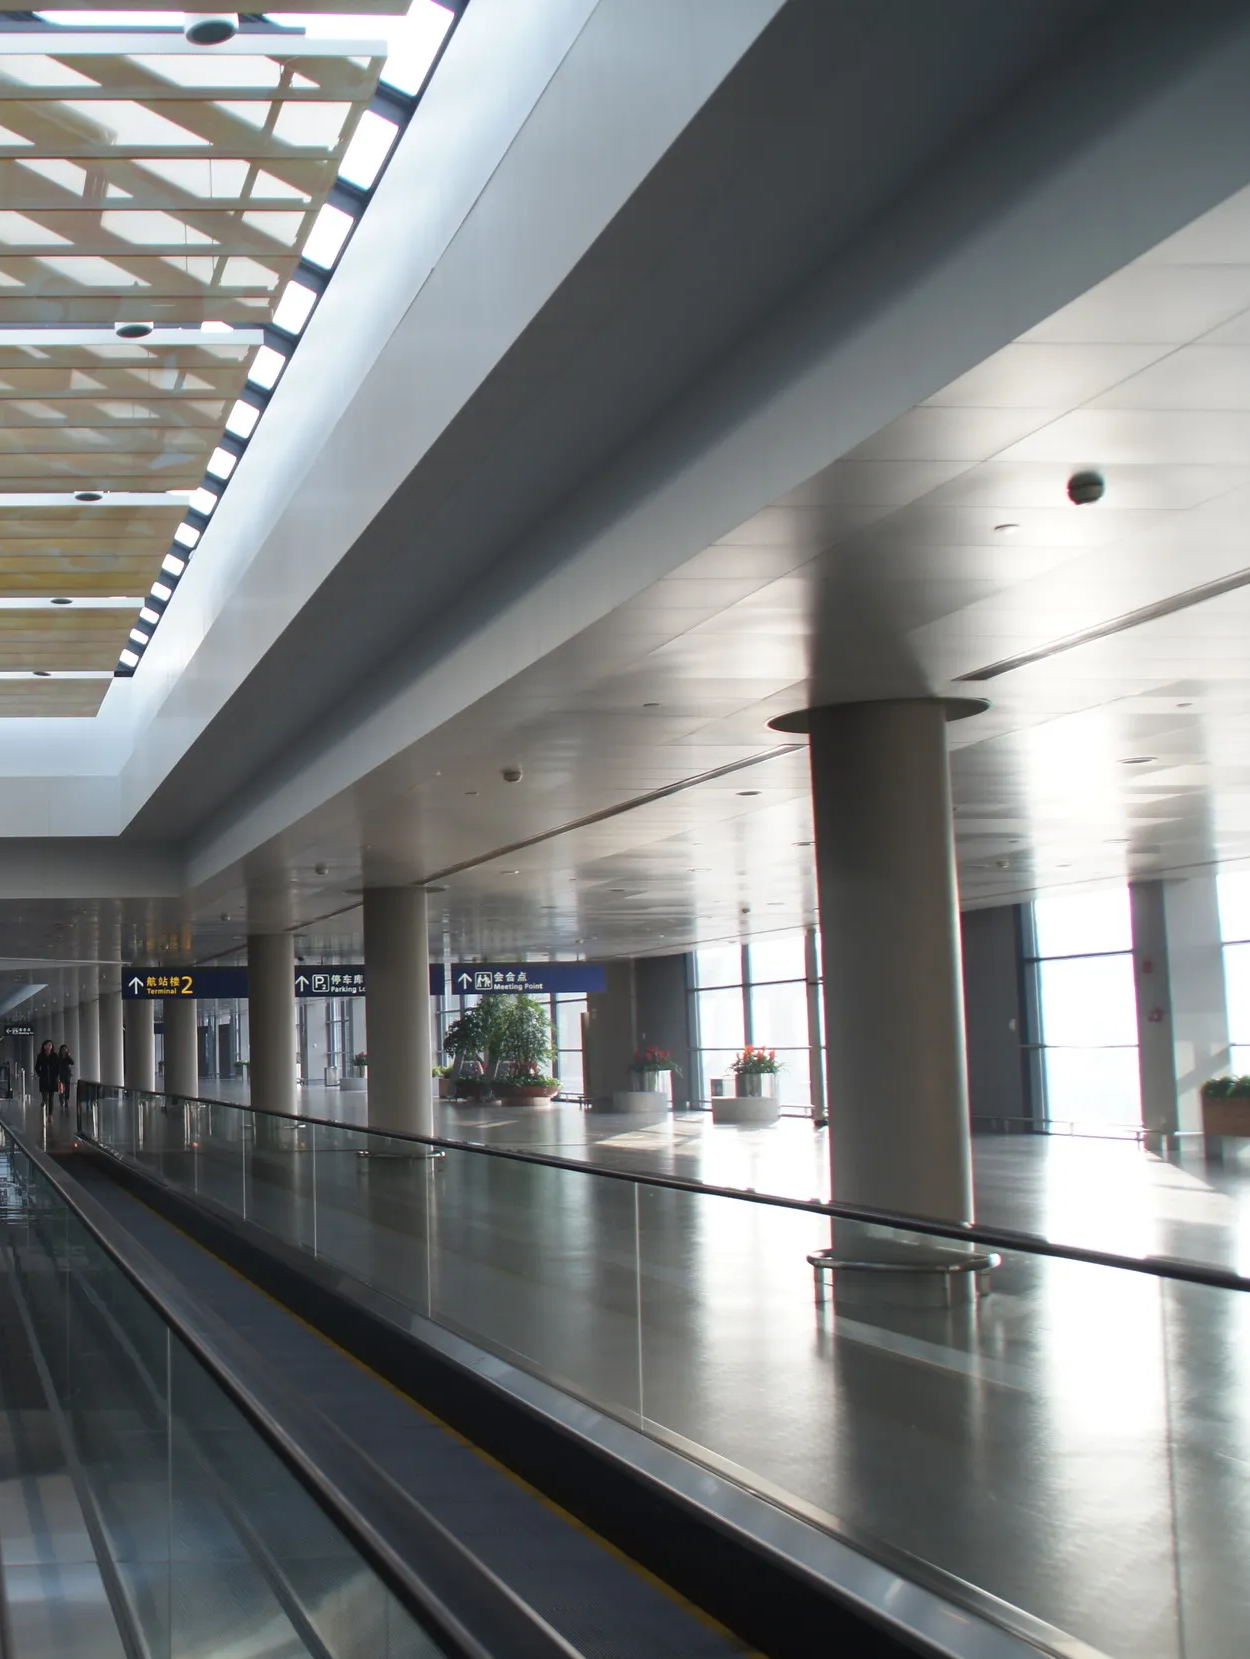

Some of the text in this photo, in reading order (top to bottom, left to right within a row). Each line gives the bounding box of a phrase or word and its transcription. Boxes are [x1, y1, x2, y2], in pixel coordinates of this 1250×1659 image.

[331, 974, 364, 985] 停车库
[493, 971, 528, 982] 会合点
[146, 975, 193, 995] 航站楼 2
[493, 983, 523, 991] Meeting
[146, 987, 177, 995] Terminal
[331, 986, 357, 994] Parking
